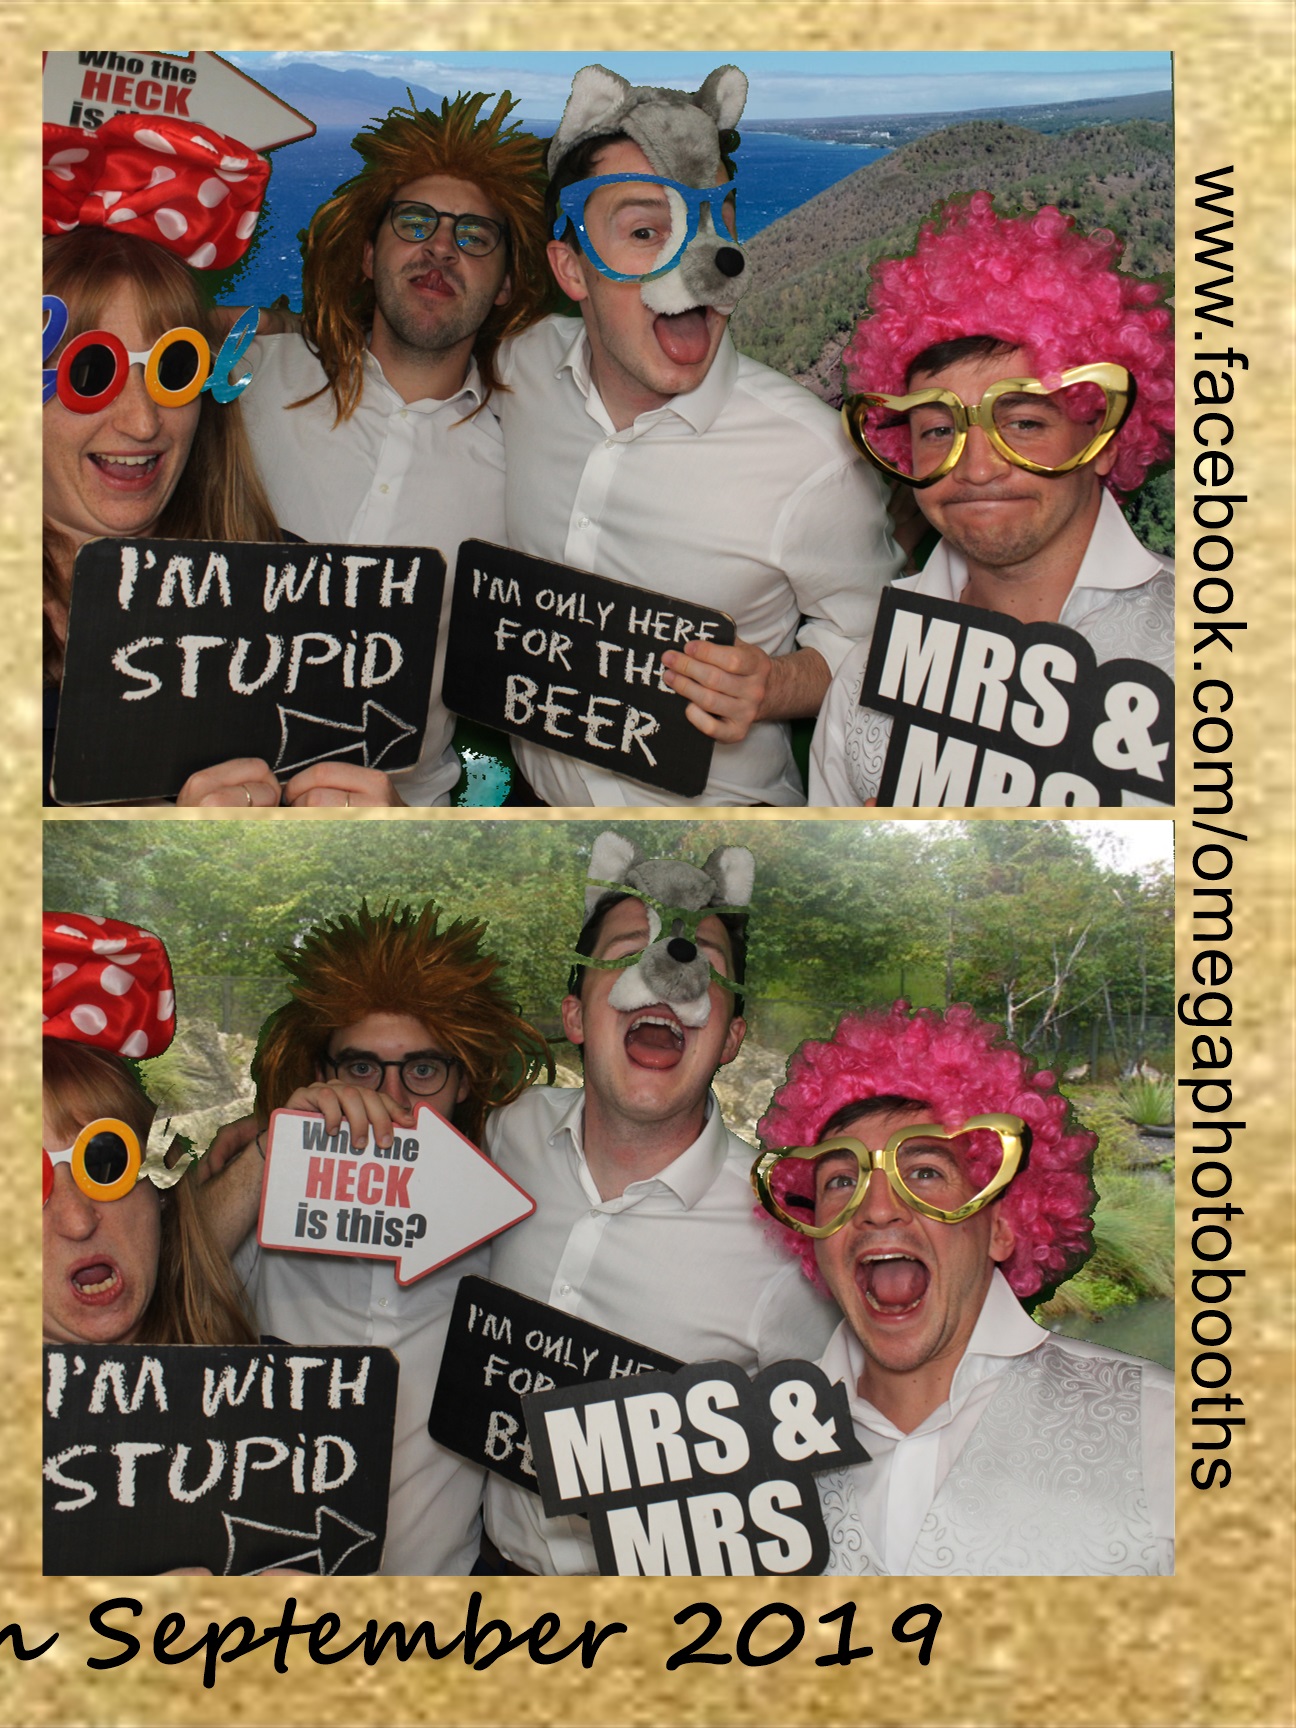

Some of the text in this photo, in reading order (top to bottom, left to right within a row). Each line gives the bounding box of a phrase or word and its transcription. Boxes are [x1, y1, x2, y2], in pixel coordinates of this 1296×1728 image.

[78, 51, 197, 85] Who the
[80, 69, 193, 117] HECK
[69, 101, 105, 131] is
[118, 546, 232, 611] I'M
[471, 568, 720, 643] I'M ONLY HERE
[494, 617, 573, 671] FOR
[504, 674, 661, 766] BEER
[877, 608, 1170, 782] MRS &
[305, 1156, 415, 1208] HECK
[295, 1202, 427, 1248] is this?
[468, 1303, 512, 1344] I'M
[525, 1330, 599, 1376] ONLY
[46, 1352, 169, 1418] I'M
[543, 1379, 750, 1500] MRS
[769, 1380, 842, 1462] &
[606, 1480, 813, 1576] MRS
